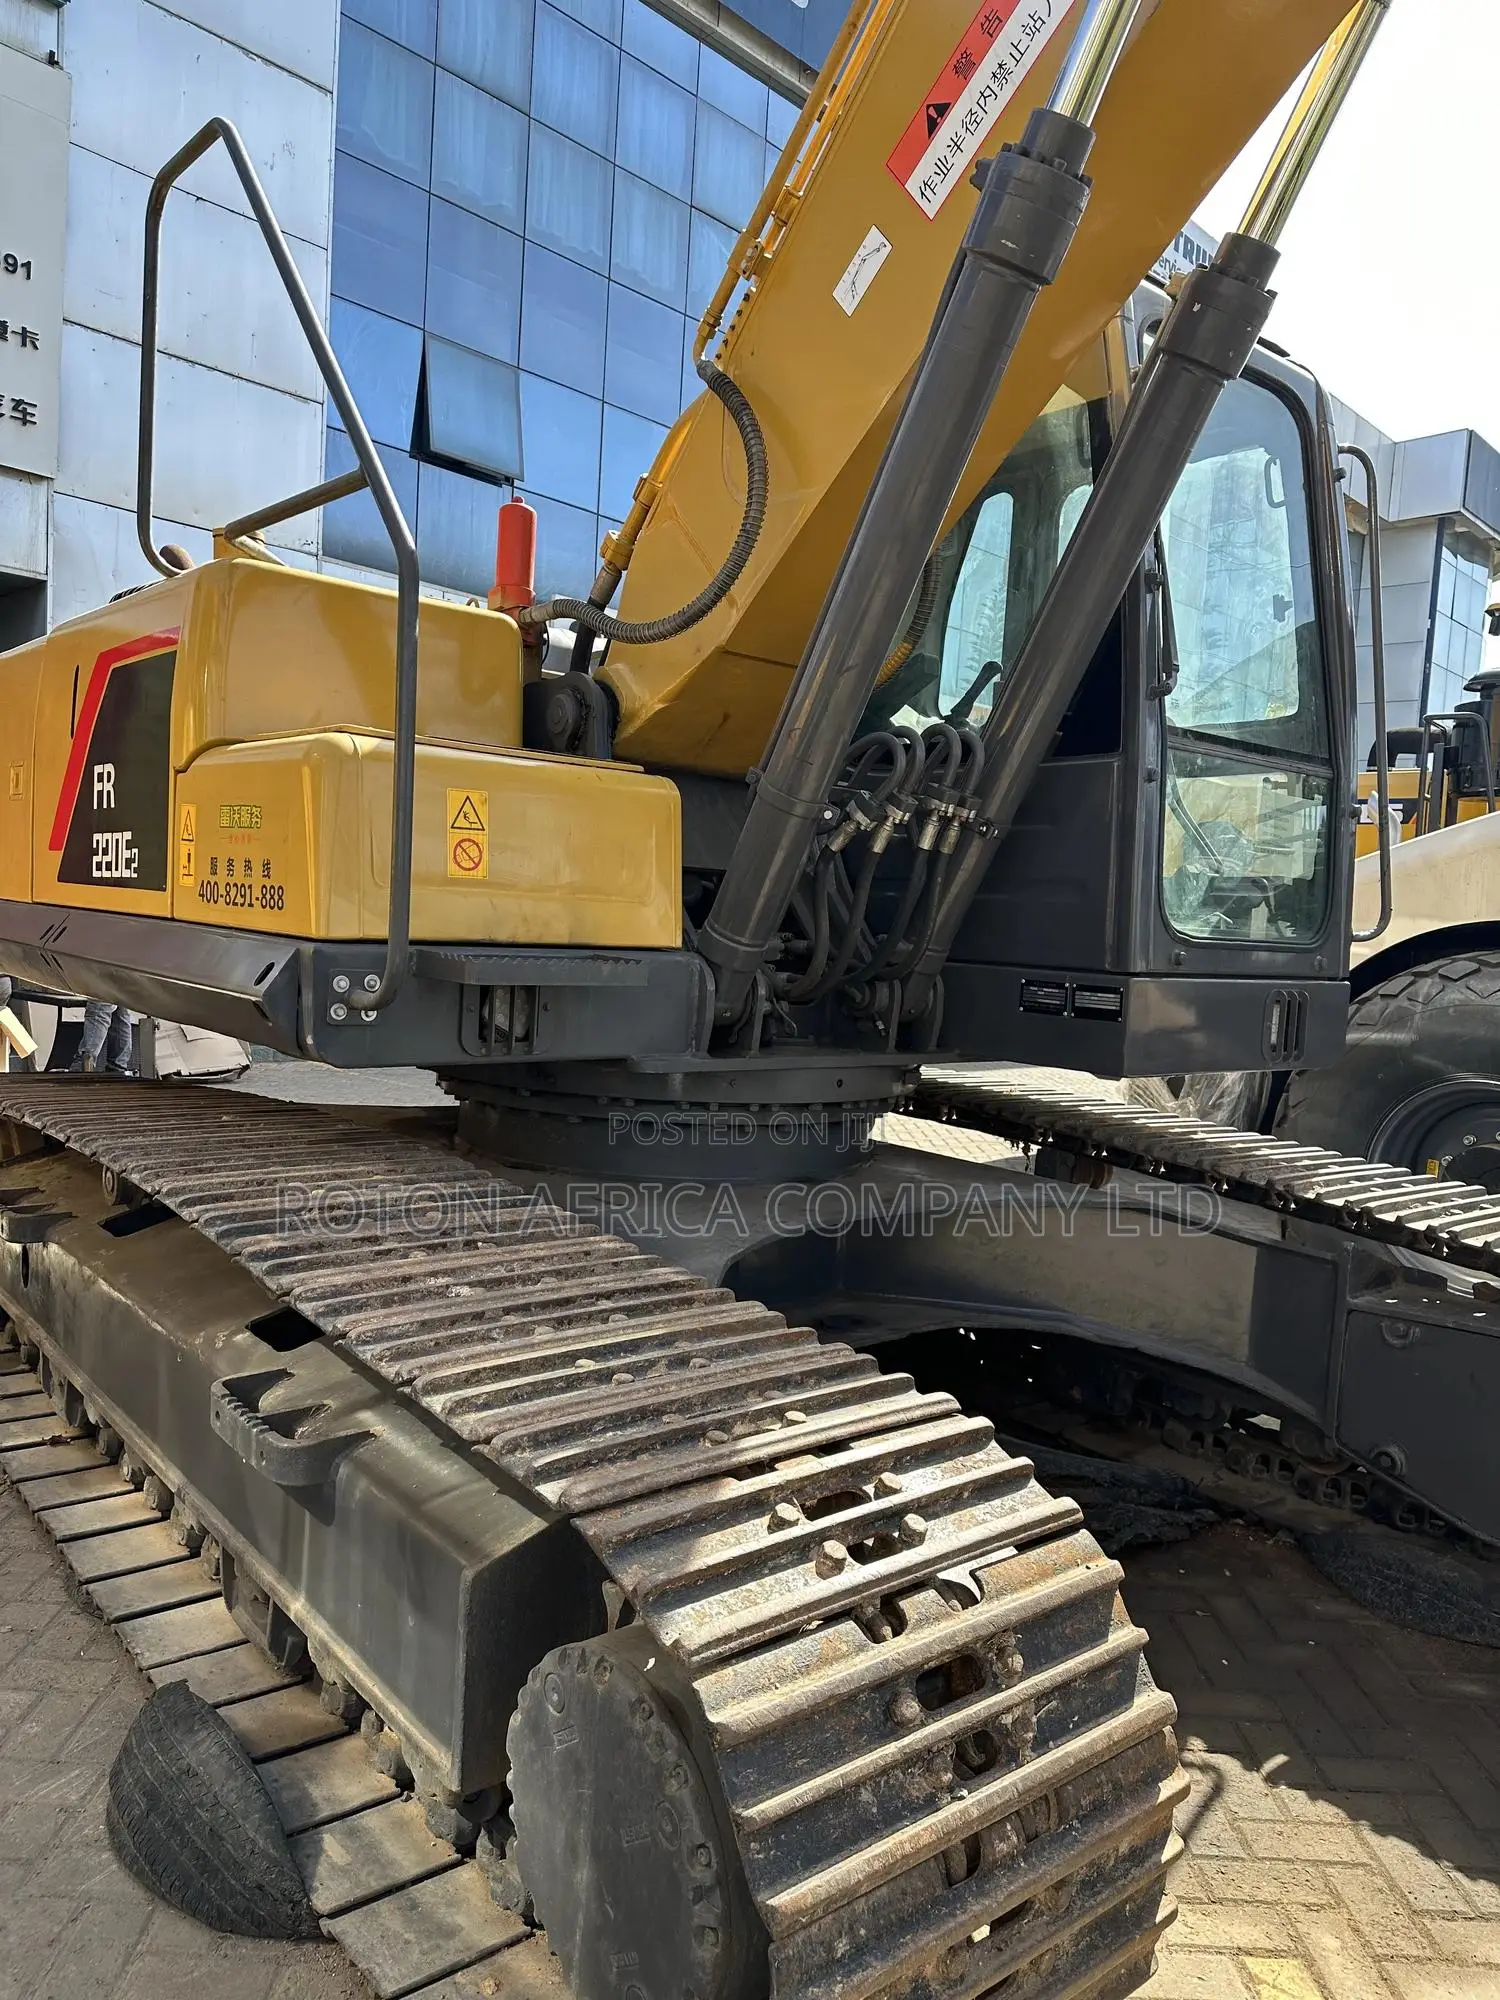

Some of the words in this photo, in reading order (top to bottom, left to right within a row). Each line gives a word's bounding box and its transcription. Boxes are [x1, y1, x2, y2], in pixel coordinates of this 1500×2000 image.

[0, 253, 33, 281] 91
[0, 394, 38, 427] 车
[93, 763, 116, 810] FR
[210, 856, 271, 879] 服务热线
[198, 880, 285, 911] 400-8291-888
